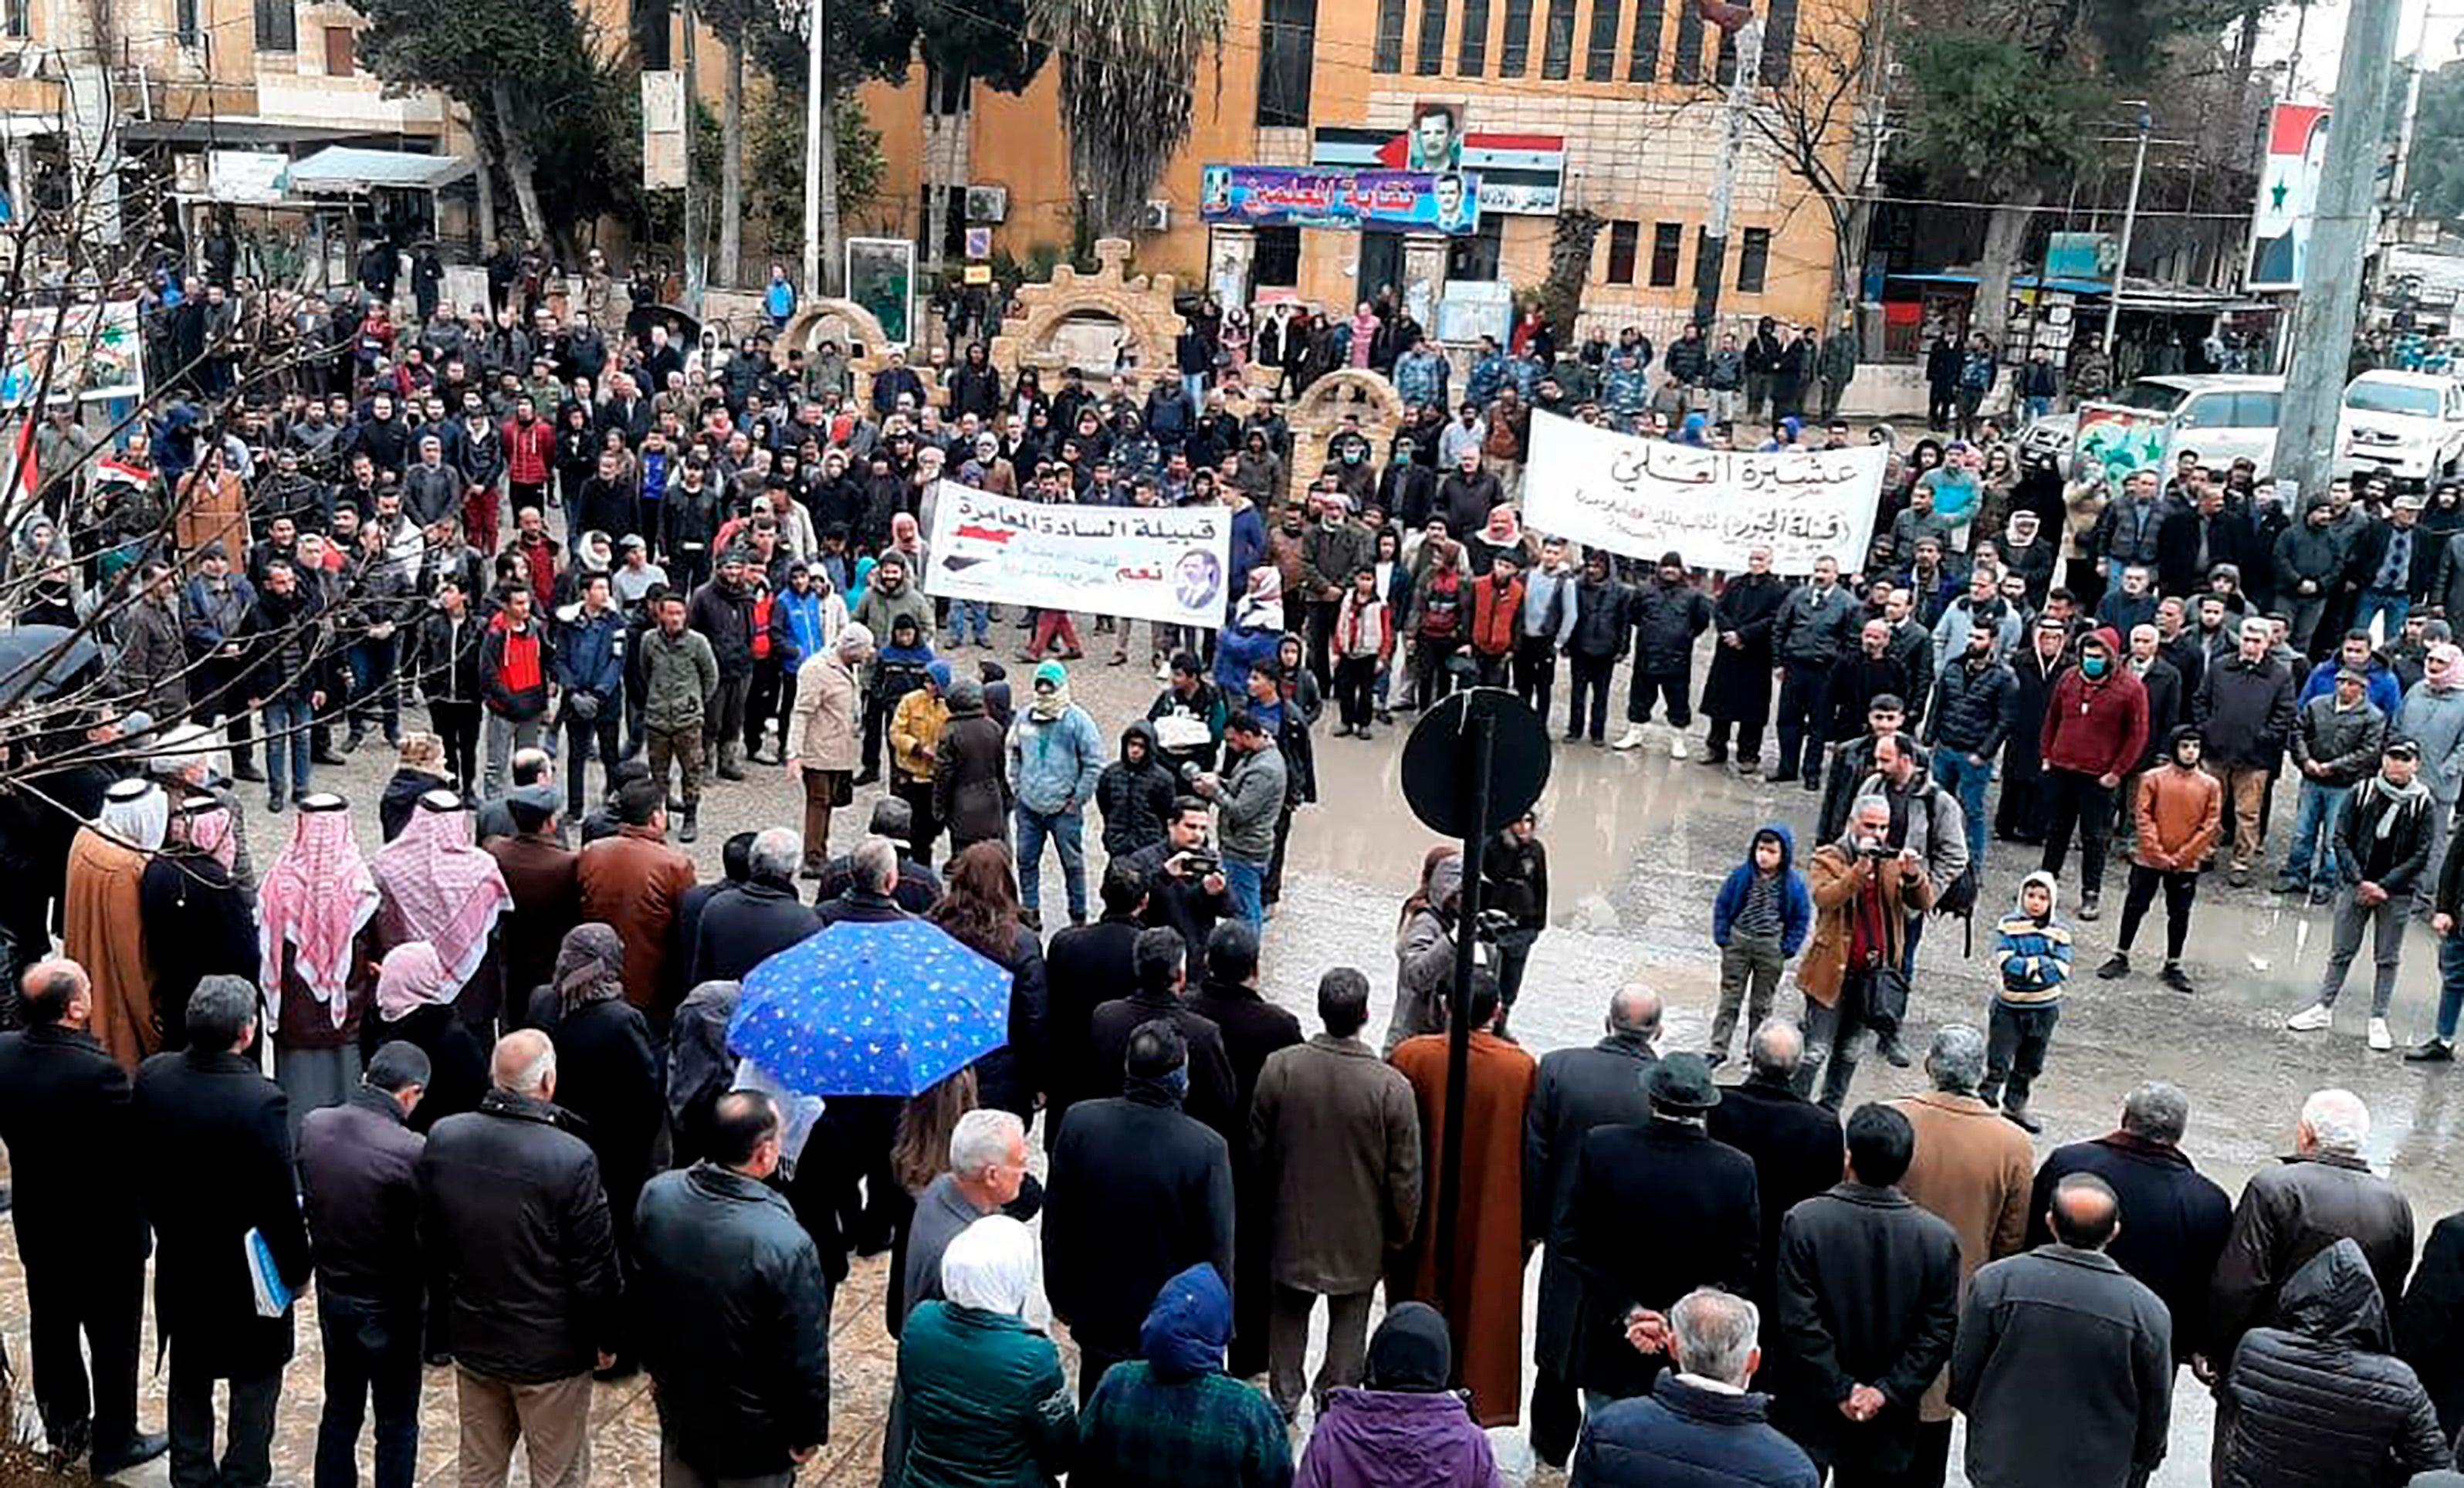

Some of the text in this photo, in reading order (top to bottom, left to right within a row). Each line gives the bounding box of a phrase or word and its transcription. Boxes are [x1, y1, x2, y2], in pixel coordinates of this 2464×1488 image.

[1340, 178, 1416, 218] نقابة
[1741, 455, 1857, 494] عشيرة
[960, 495, 1216, 546] قبيلة السادة المعامرة
[1116, 560, 1163, 582] نعم
